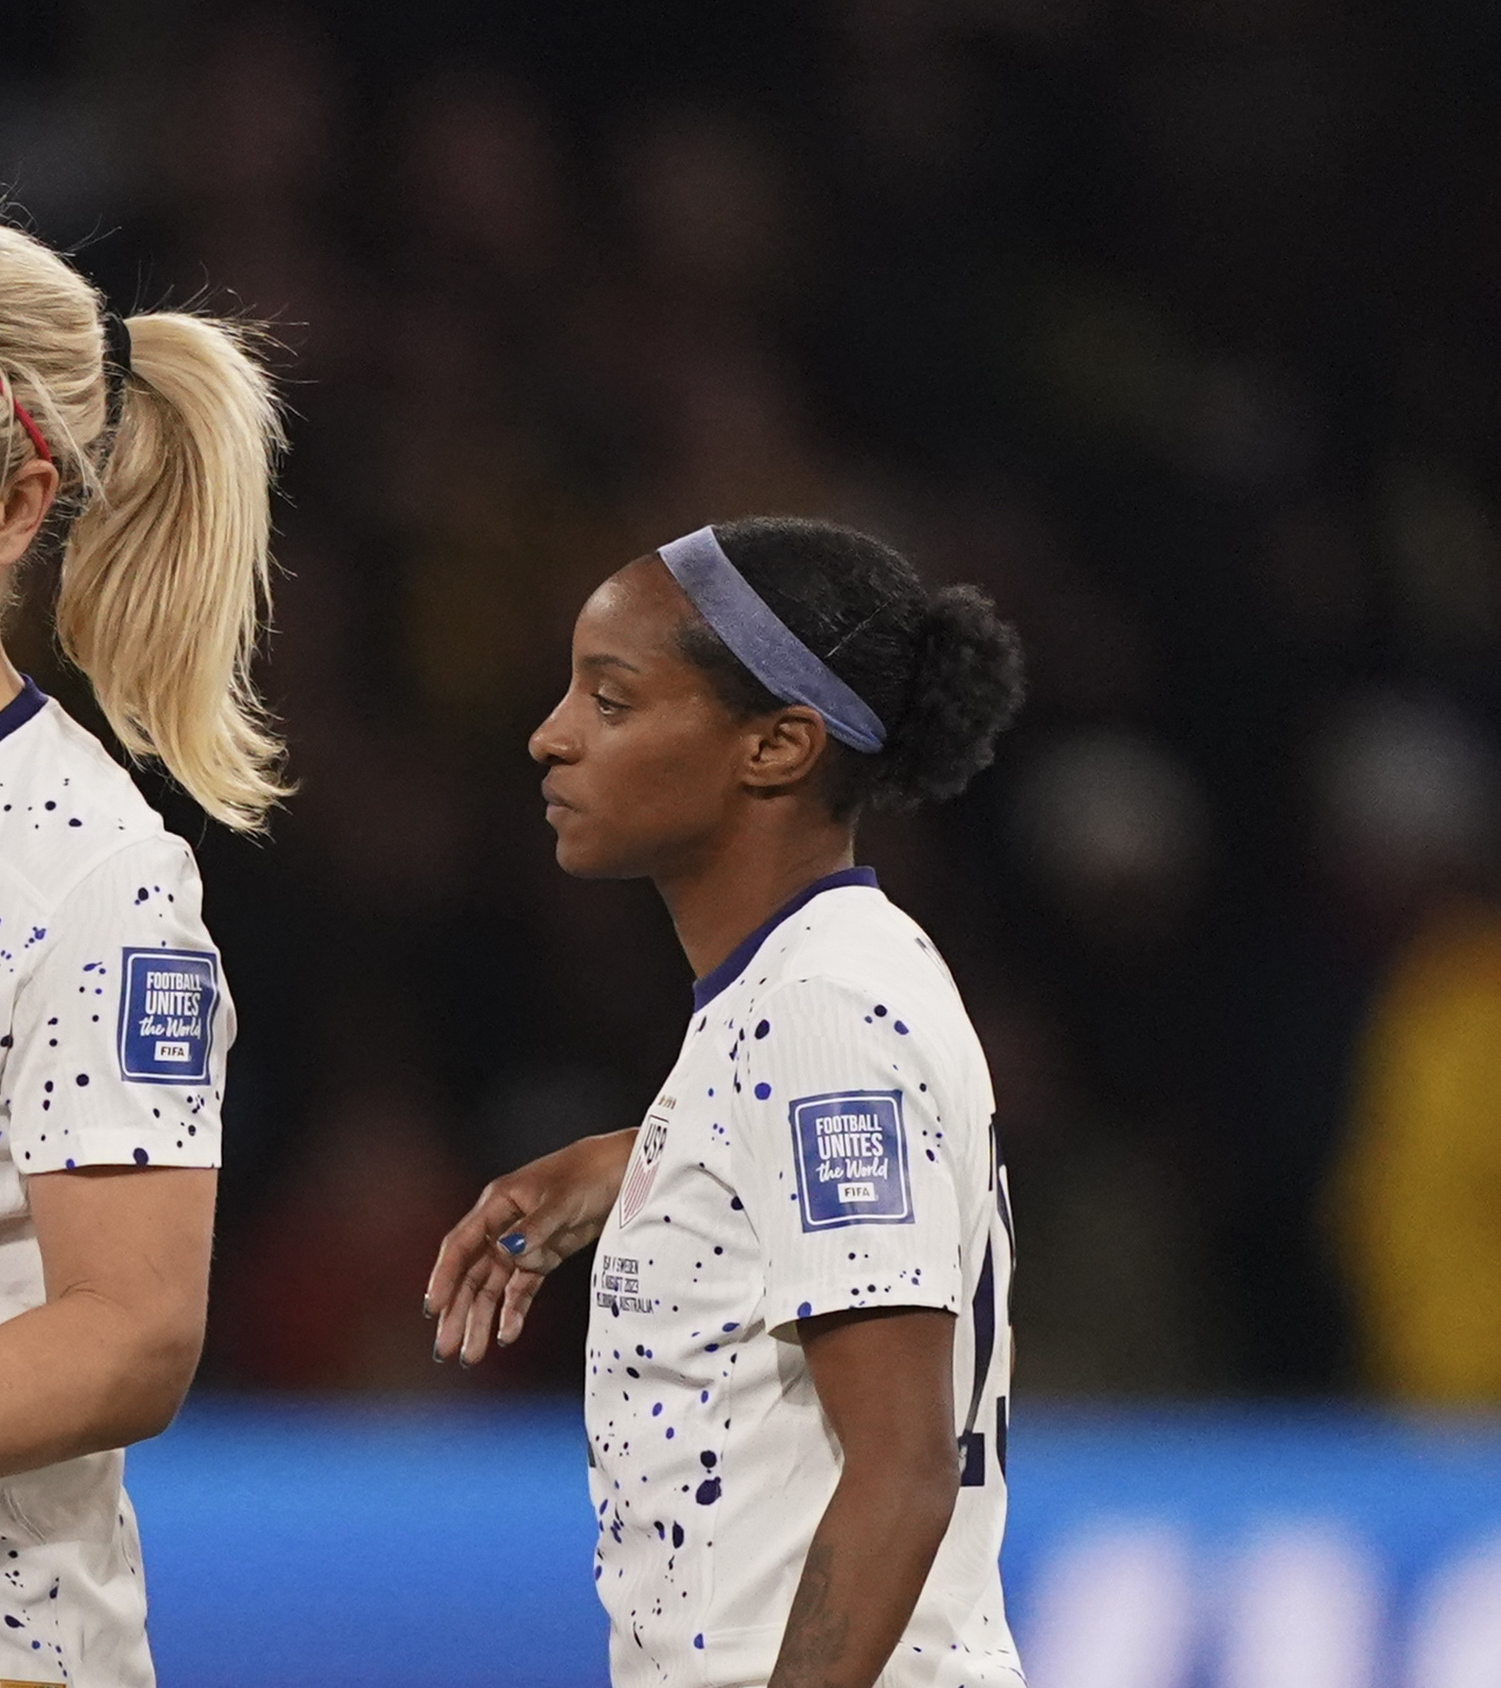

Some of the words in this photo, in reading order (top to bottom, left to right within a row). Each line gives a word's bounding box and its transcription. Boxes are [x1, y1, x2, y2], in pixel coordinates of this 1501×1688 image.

[146, 972, 203, 992] FOOTBALL
[145, 990, 201, 1017] UNITES
[139, 1015, 166, 1037] the
[165, 1017, 202, 1040] World
[160, 1046, 185, 1057] FIFA
[815, 1114, 883, 1135] FOOTBALL
[817, 1133, 884, 1160] UNITES
[816, 1160, 845, 1183] the
[845, 1157, 889, 1180] World
[844, 1187, 871, 1197] FIFA
